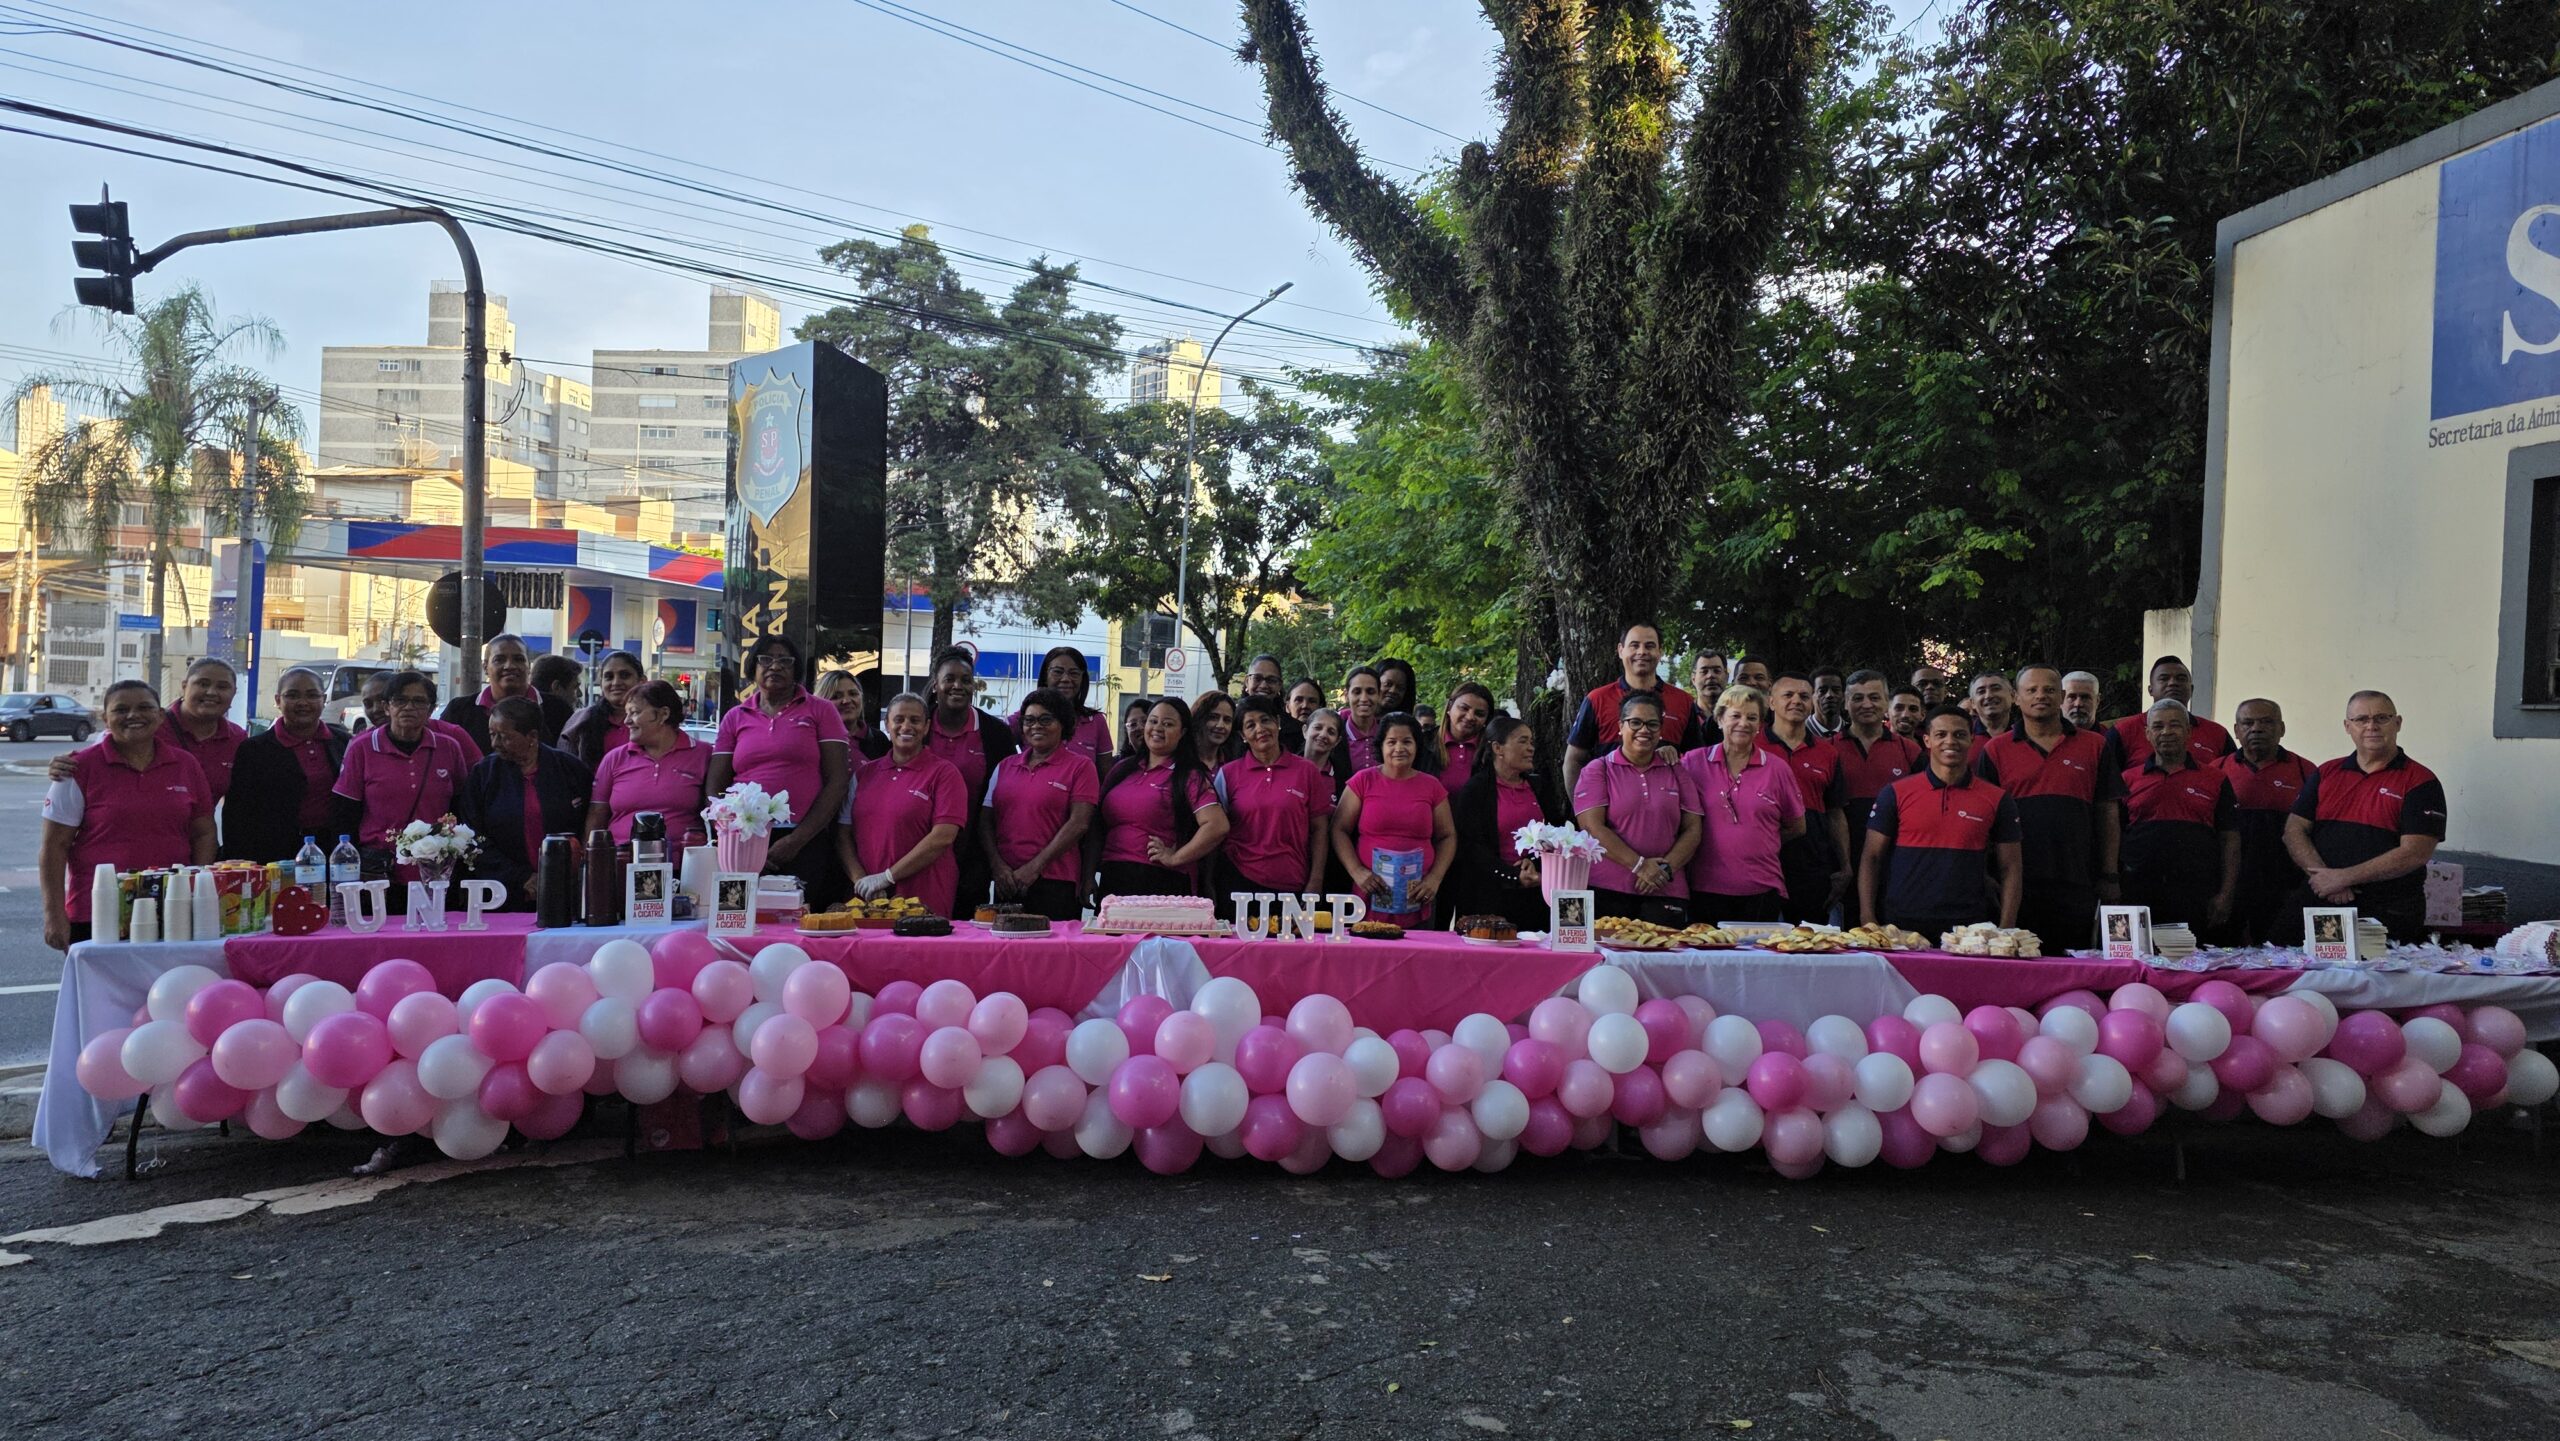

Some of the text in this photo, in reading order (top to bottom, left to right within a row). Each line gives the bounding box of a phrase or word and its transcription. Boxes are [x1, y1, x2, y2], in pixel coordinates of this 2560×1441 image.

[2428, 418, 2503, 448] Secretaria
[2507, 413, 2525, 434] da
[754, 485, 781, 499] PENAL
[1231, 892, 1366, 943] UNP
